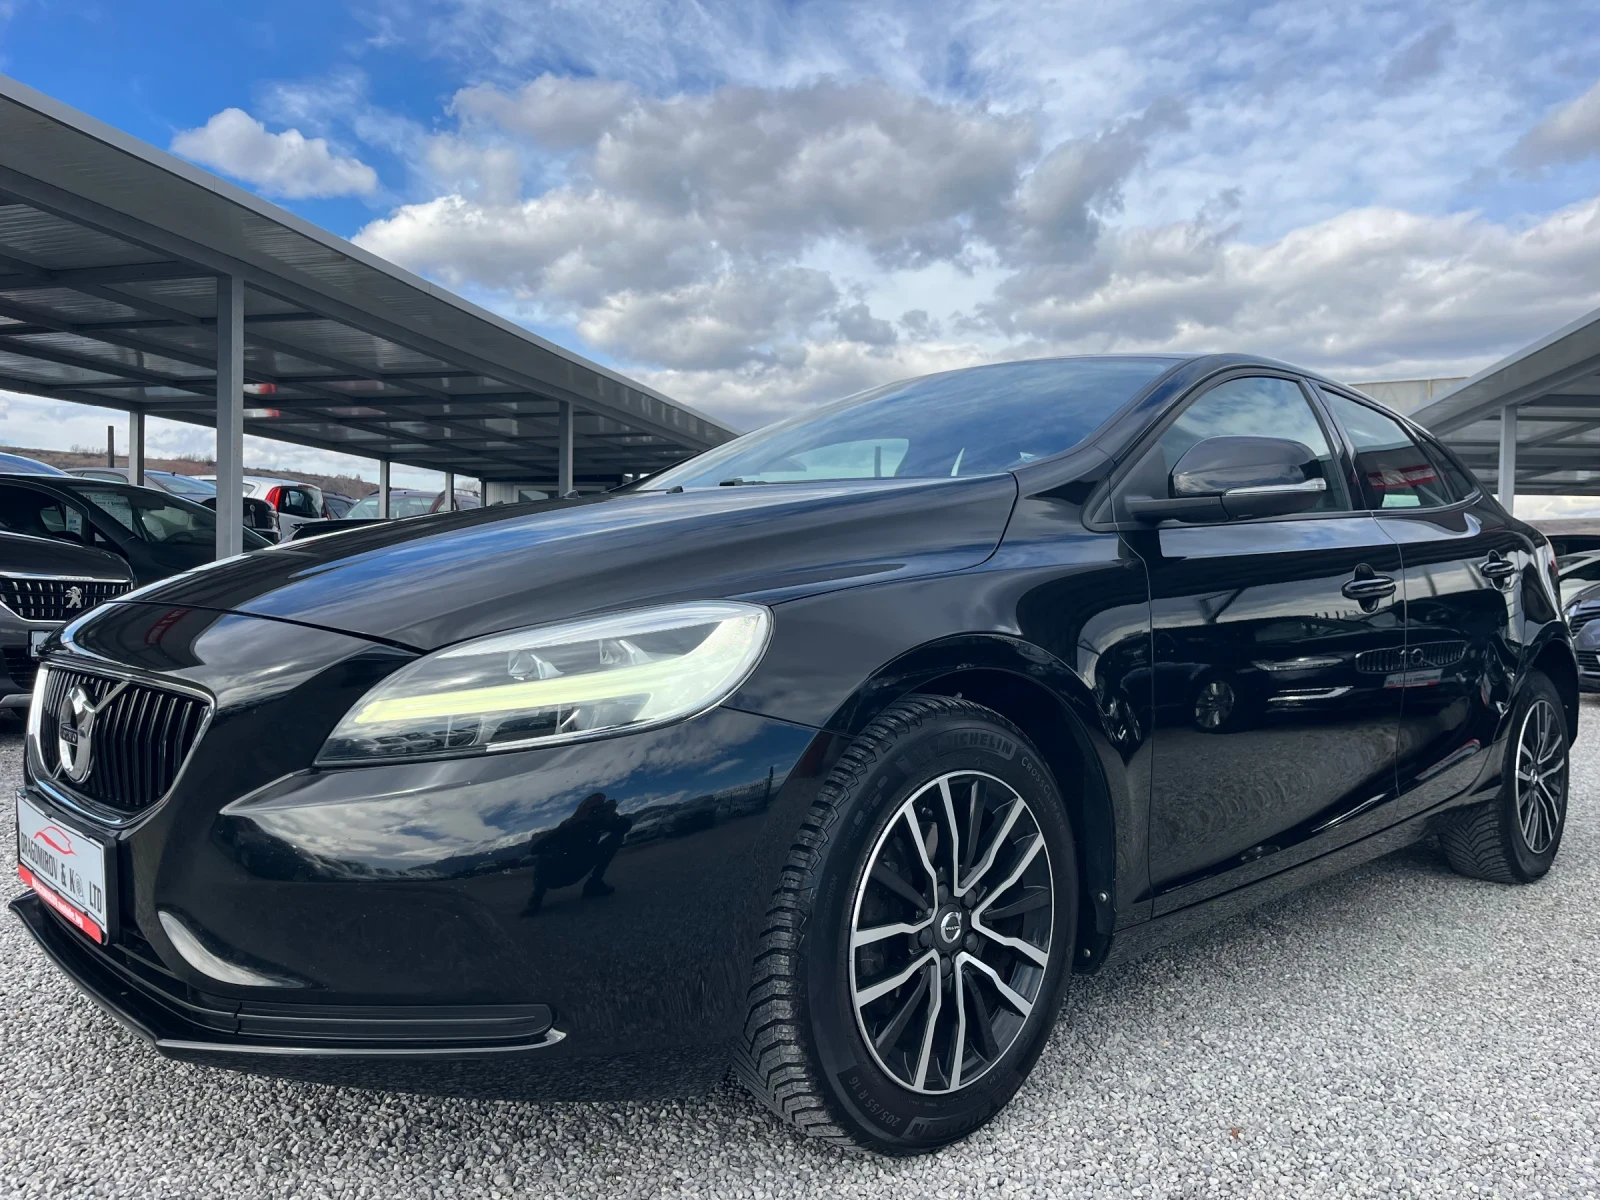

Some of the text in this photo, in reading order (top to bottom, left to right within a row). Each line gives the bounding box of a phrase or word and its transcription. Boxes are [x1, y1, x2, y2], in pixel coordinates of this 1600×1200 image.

[61, 863, 67, 888] &
[89, 880, 102, 915] LTD
[847, 1075, 902, 1128] 205/55 R 16
